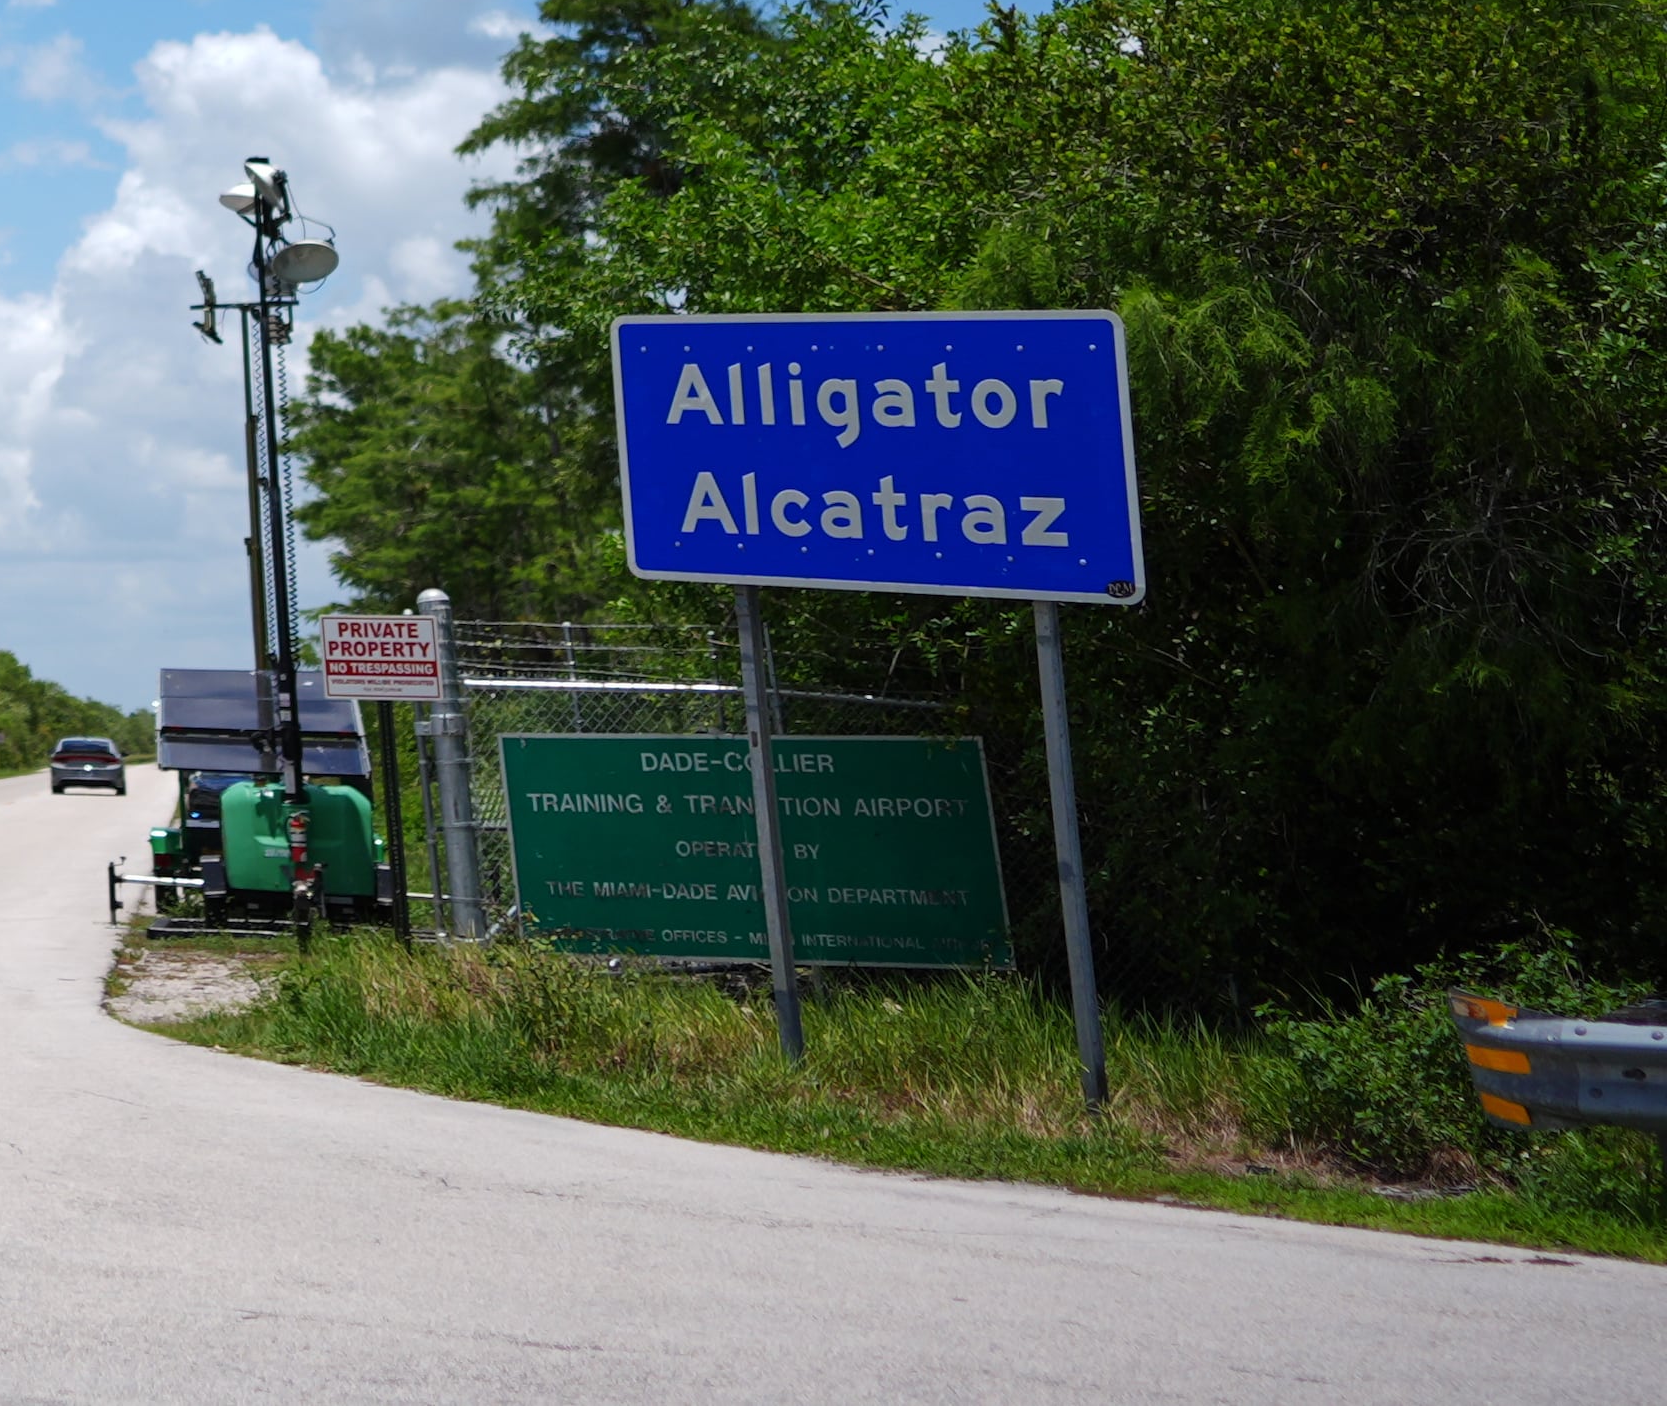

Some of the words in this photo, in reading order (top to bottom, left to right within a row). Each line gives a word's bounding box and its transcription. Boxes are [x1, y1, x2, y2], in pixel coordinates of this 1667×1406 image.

[667, 361, 1065, 449] Alligator
[680, 470, 1069, 548] Alcatraz
[337, 621, 419, 639] PRIVATE
[327, 640, 431, 658] PROPERTY
[329, 662, 348, 674] NO
[349, 662, 435, 675] TRESPASSING
[640, 751, 835, 774] DADE-CLIER
[526, 793, 644, 814] TRAINING
[655, 794, 673, 815] &
[682, 794, 841, 818] TRANTION
[853, 796, 968, 818] AIRPORT
[674, 840, 759, 860] OPERAT
[793, 843, 820, 860] BY
[545, 879, 586, 897] THE
[592, 880, 719, 901] MIAMI-DADE
[826, 887, 968, 907] DEPARTMENT
[661, 928, 729, 944] OFFICES
